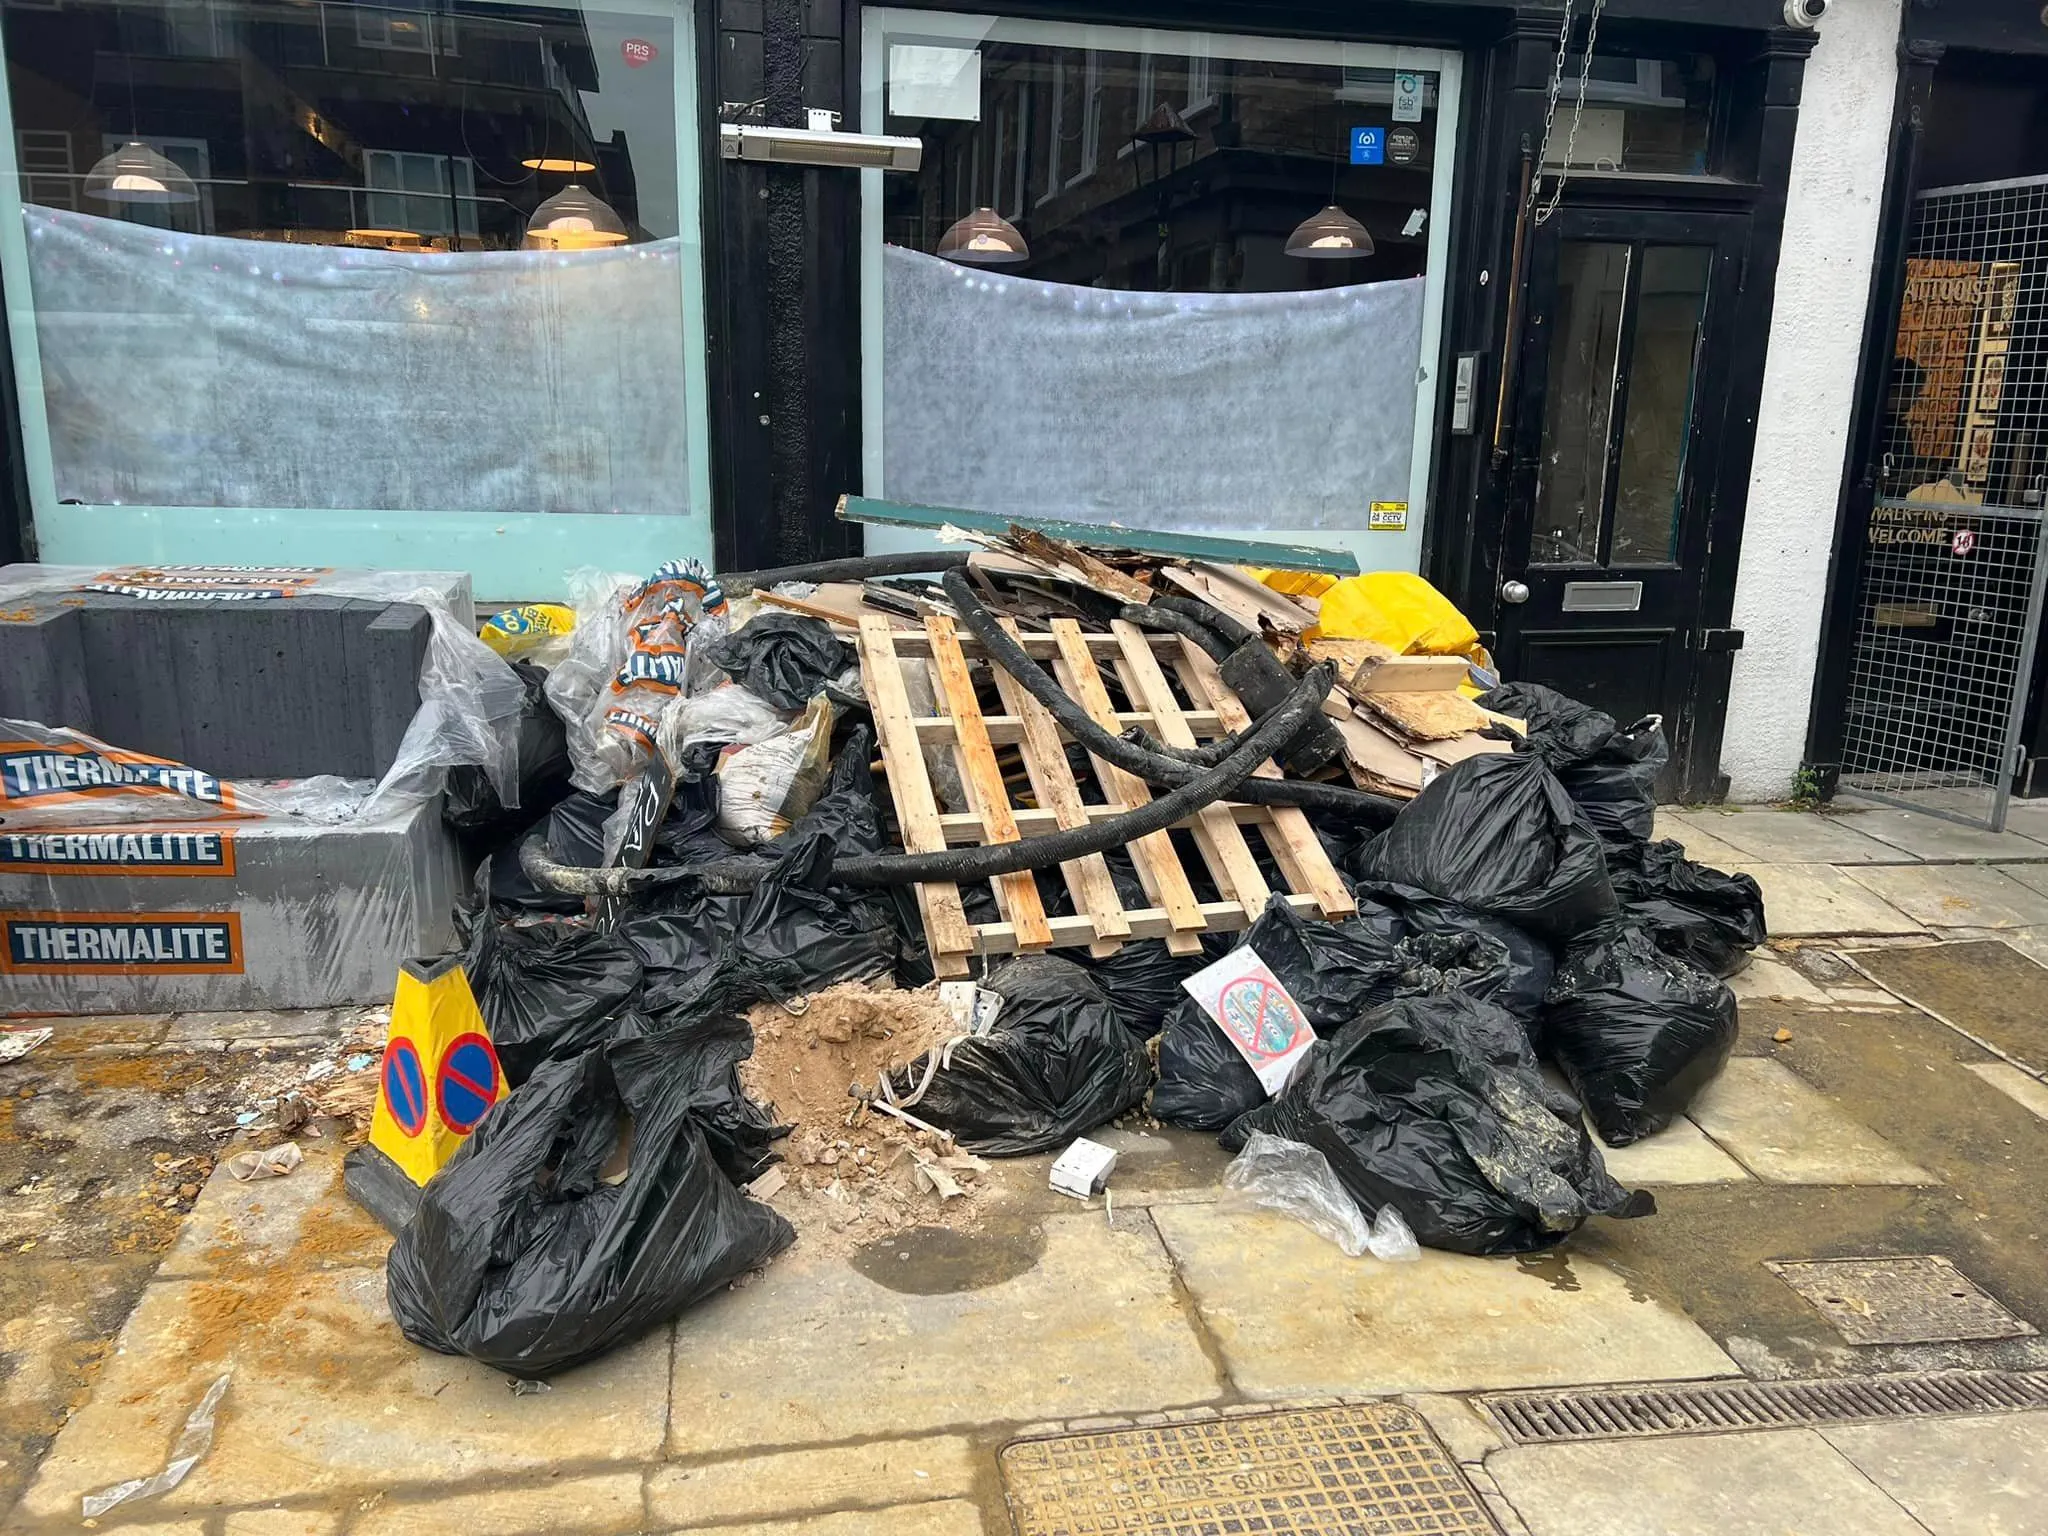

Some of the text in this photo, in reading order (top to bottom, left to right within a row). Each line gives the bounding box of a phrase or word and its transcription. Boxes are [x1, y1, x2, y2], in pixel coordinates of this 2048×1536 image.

[626, 43, 649, 56] PRS
[1398, 95, 1414, 106] fsb
[1903, 277, 1993, 306] ATTOOIST
[6, 755, 217, 801] THERMITE
[8, 833, 219, 861] THERMALITE
[15, 926, 227, 961] THERMALITE
